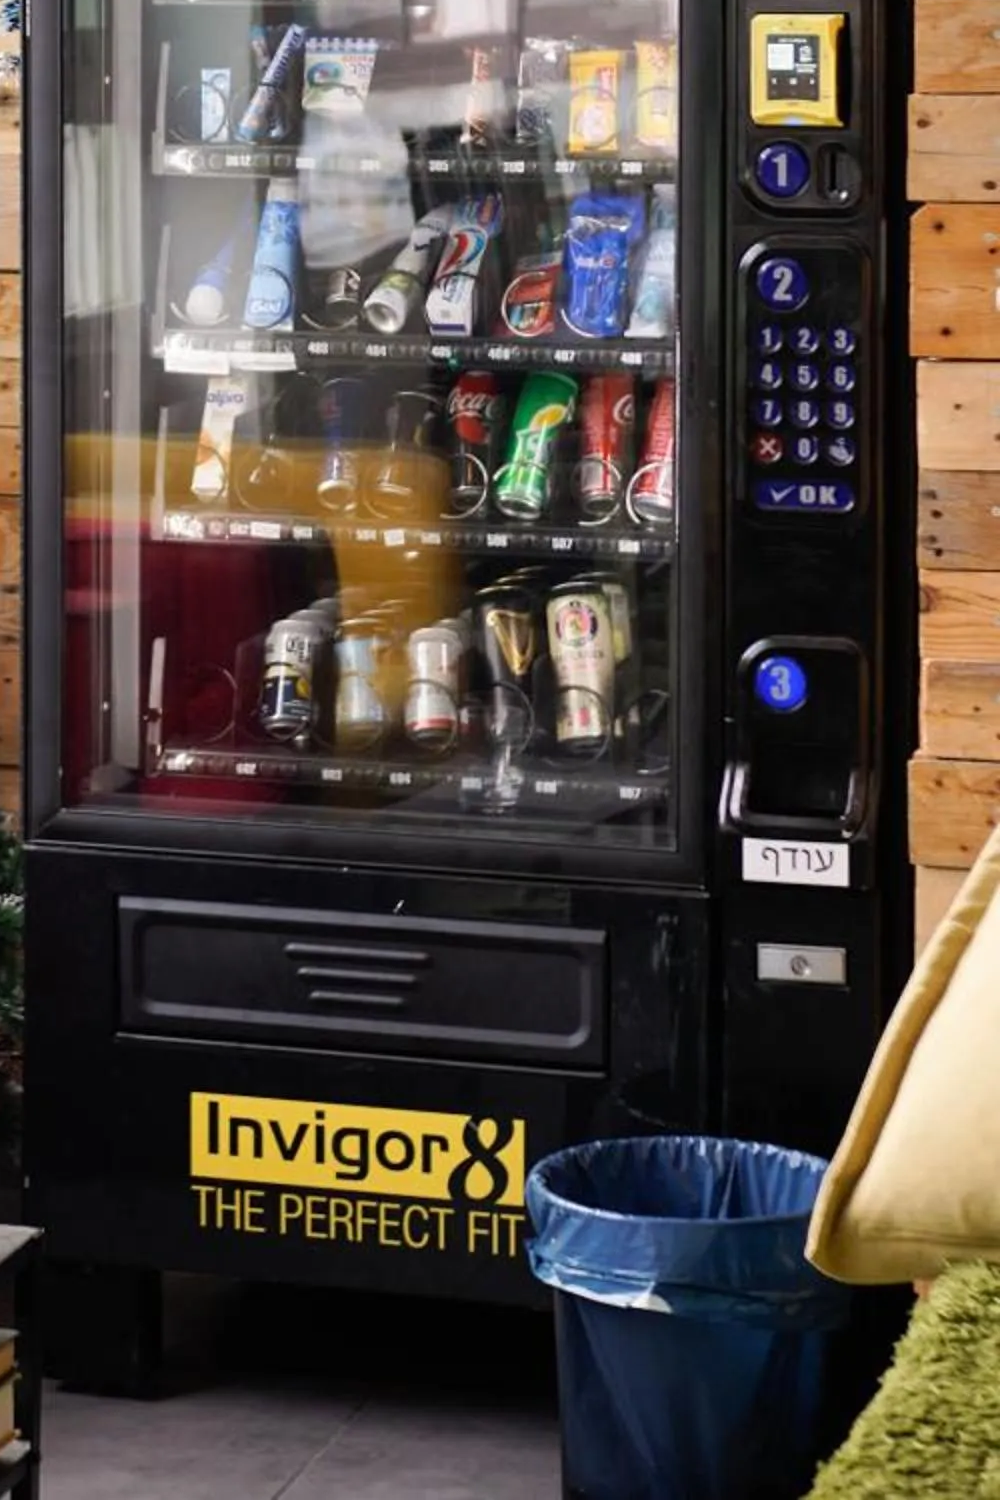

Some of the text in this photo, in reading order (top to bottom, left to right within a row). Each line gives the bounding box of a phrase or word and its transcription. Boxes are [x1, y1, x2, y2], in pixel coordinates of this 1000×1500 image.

[771, 153, 788, 187] 1
[772, 265, 793, 301] 2
[762, 326, 847, 349] 1 2 3
[760, 363, 848, 386] 4 5 6
[762, 400, 848, 422] 7 8 9
[797, 438, 811, 458] 0
[799, 485, 838, 505] OK
[770, 665, 791, 701] 3
[761, 846, 834, 877] עודף
[208, 1101, 515, 1205] Invigor8
[190, 1184, 526, 1257] THE PERFECT FIT
